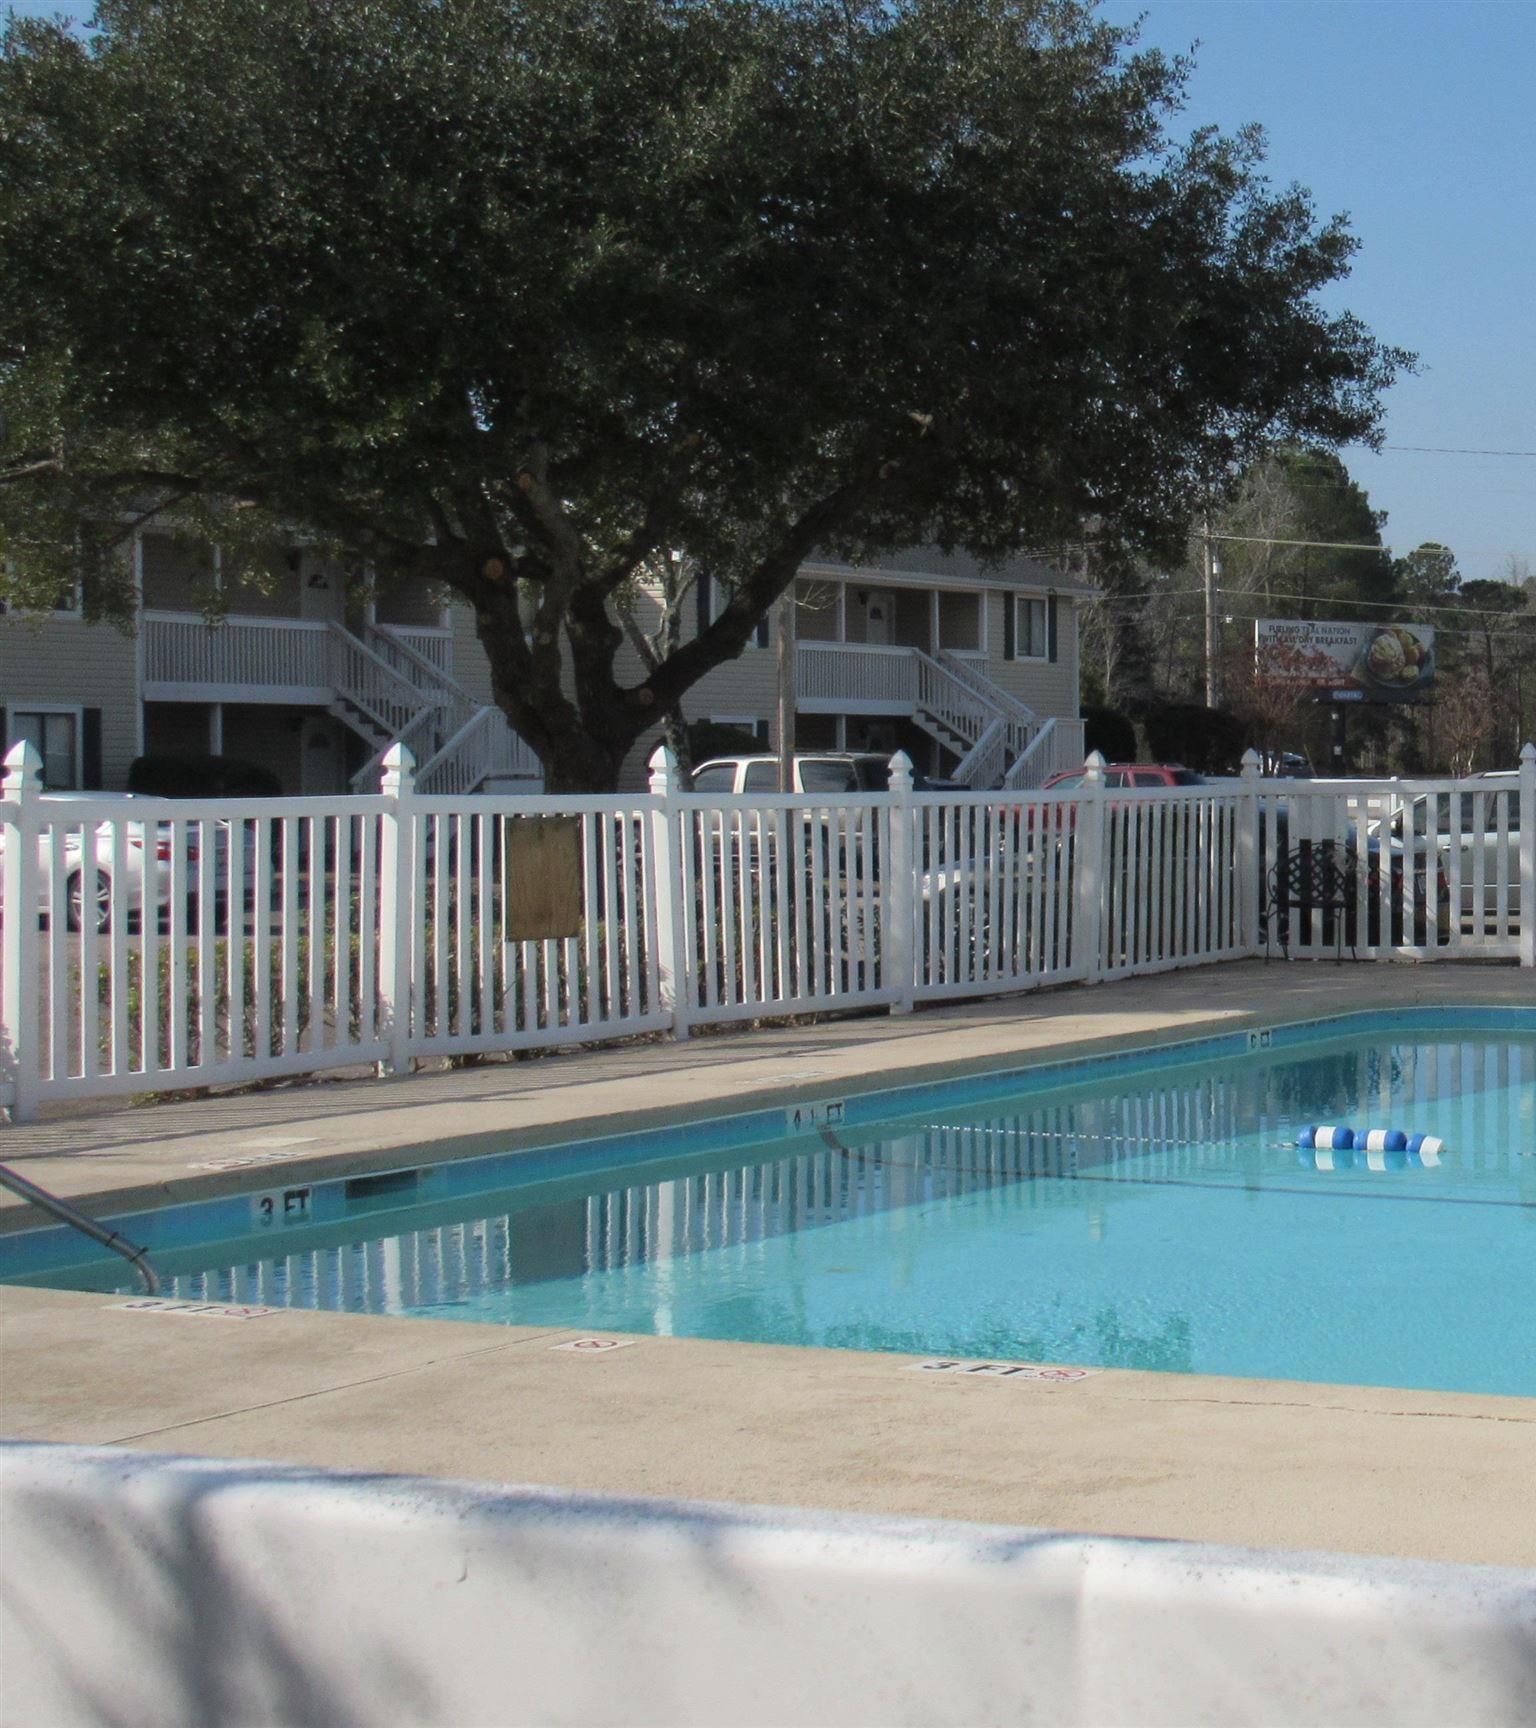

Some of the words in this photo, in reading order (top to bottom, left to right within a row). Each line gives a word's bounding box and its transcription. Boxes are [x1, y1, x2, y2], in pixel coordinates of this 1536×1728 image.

[1269, 624, 1300, 634] FUELING
[1321, 626, 1352, 636] NATION
[1315, 636, 1358, 646] BREAKFAST
[164, 1303, 224, 1313] FT
[923, 1361, 961, 1370] 3
[967, 1364, 1035, 1376] FT
